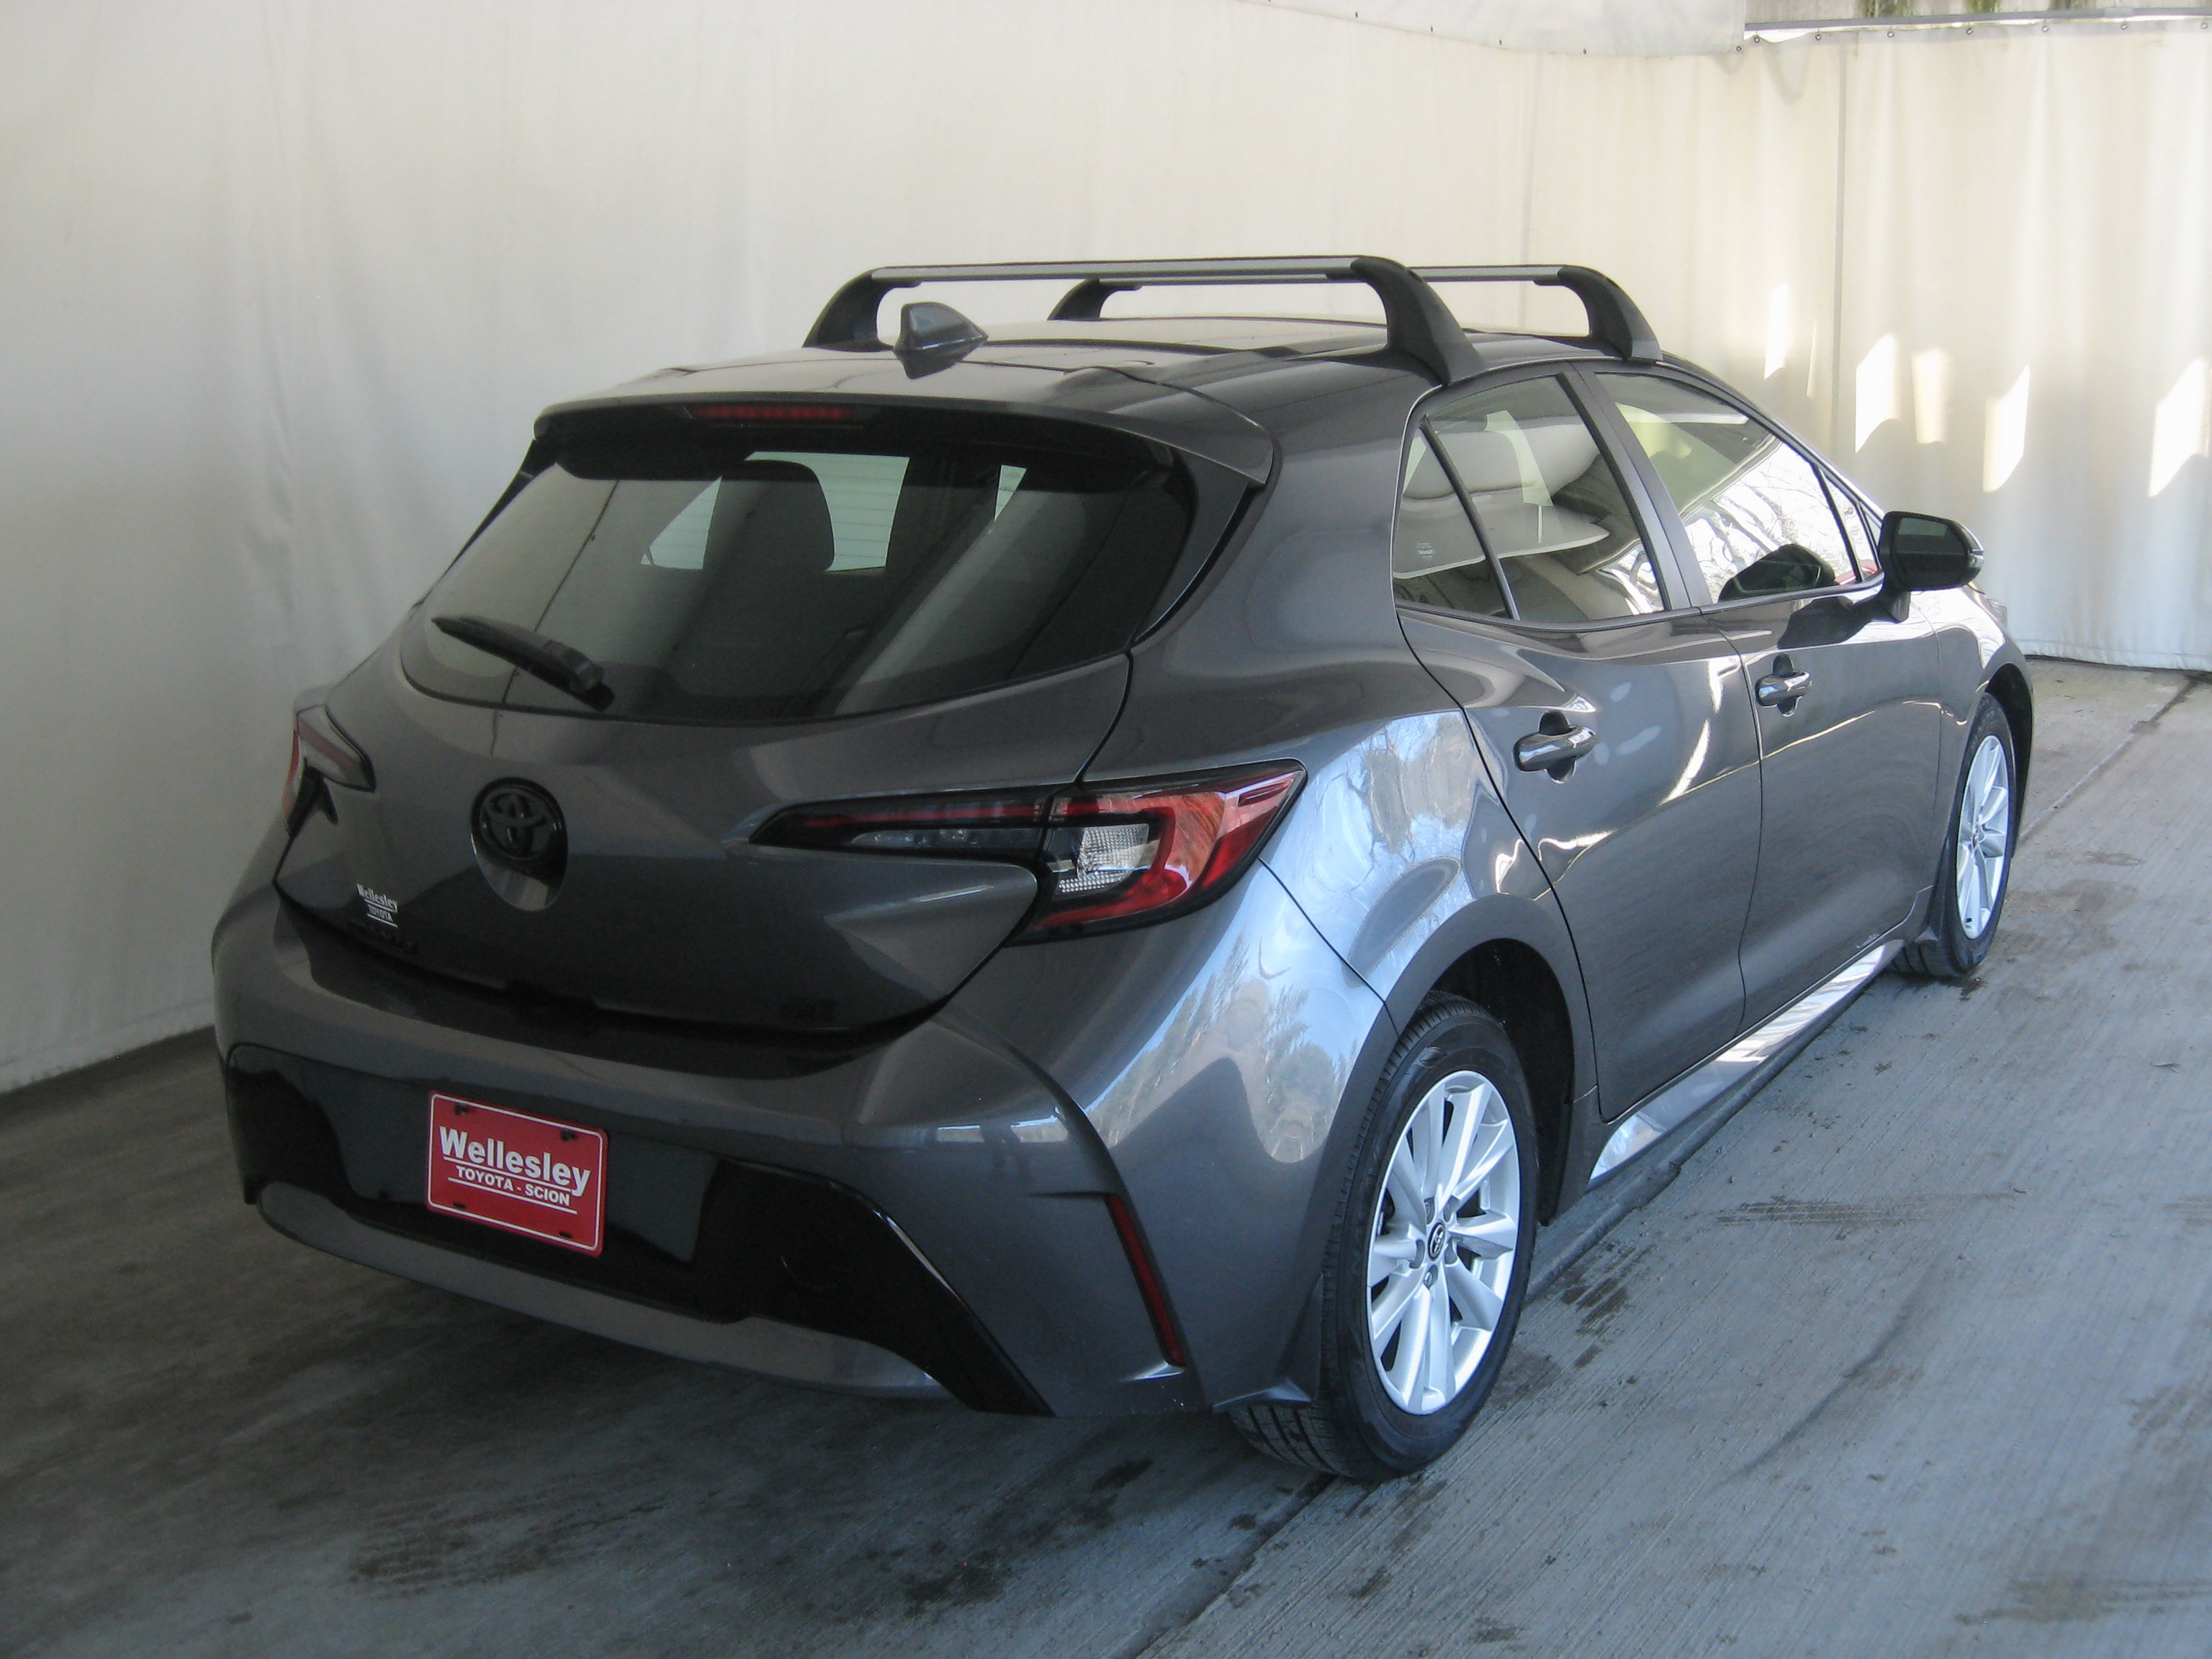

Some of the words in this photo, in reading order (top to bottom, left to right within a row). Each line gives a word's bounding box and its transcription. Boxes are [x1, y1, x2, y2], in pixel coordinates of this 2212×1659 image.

[439, 1125, 590, 1197] Wellesley
[456, 1165, 514, 1192] TOYOTA
[525, 1183, 570, 1206] SCION
